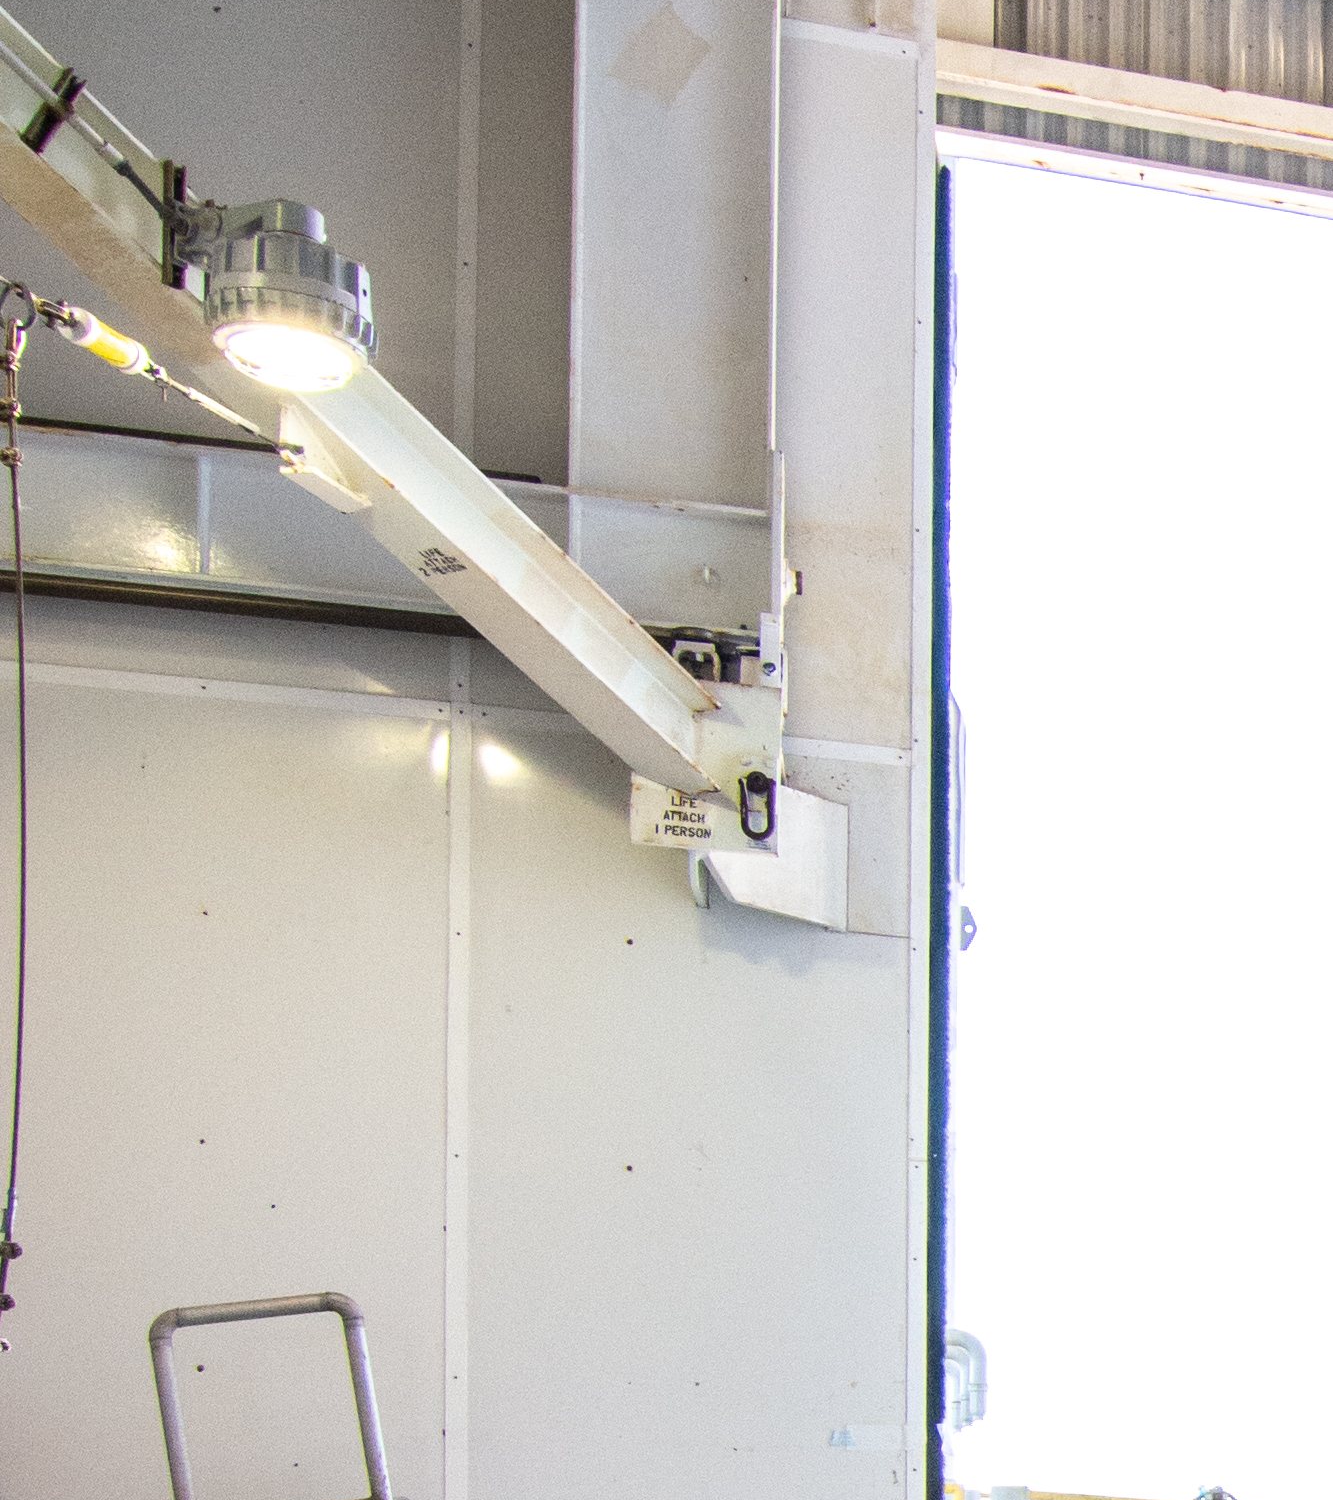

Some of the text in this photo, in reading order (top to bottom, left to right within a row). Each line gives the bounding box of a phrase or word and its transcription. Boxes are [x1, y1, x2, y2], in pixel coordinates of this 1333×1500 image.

[418, 567, 431, 577] 2
[671, 795, 698, 809] LIFE
[663, 809, 706, 824] ATTACH
[664, 824, 712, 839] PERSON
